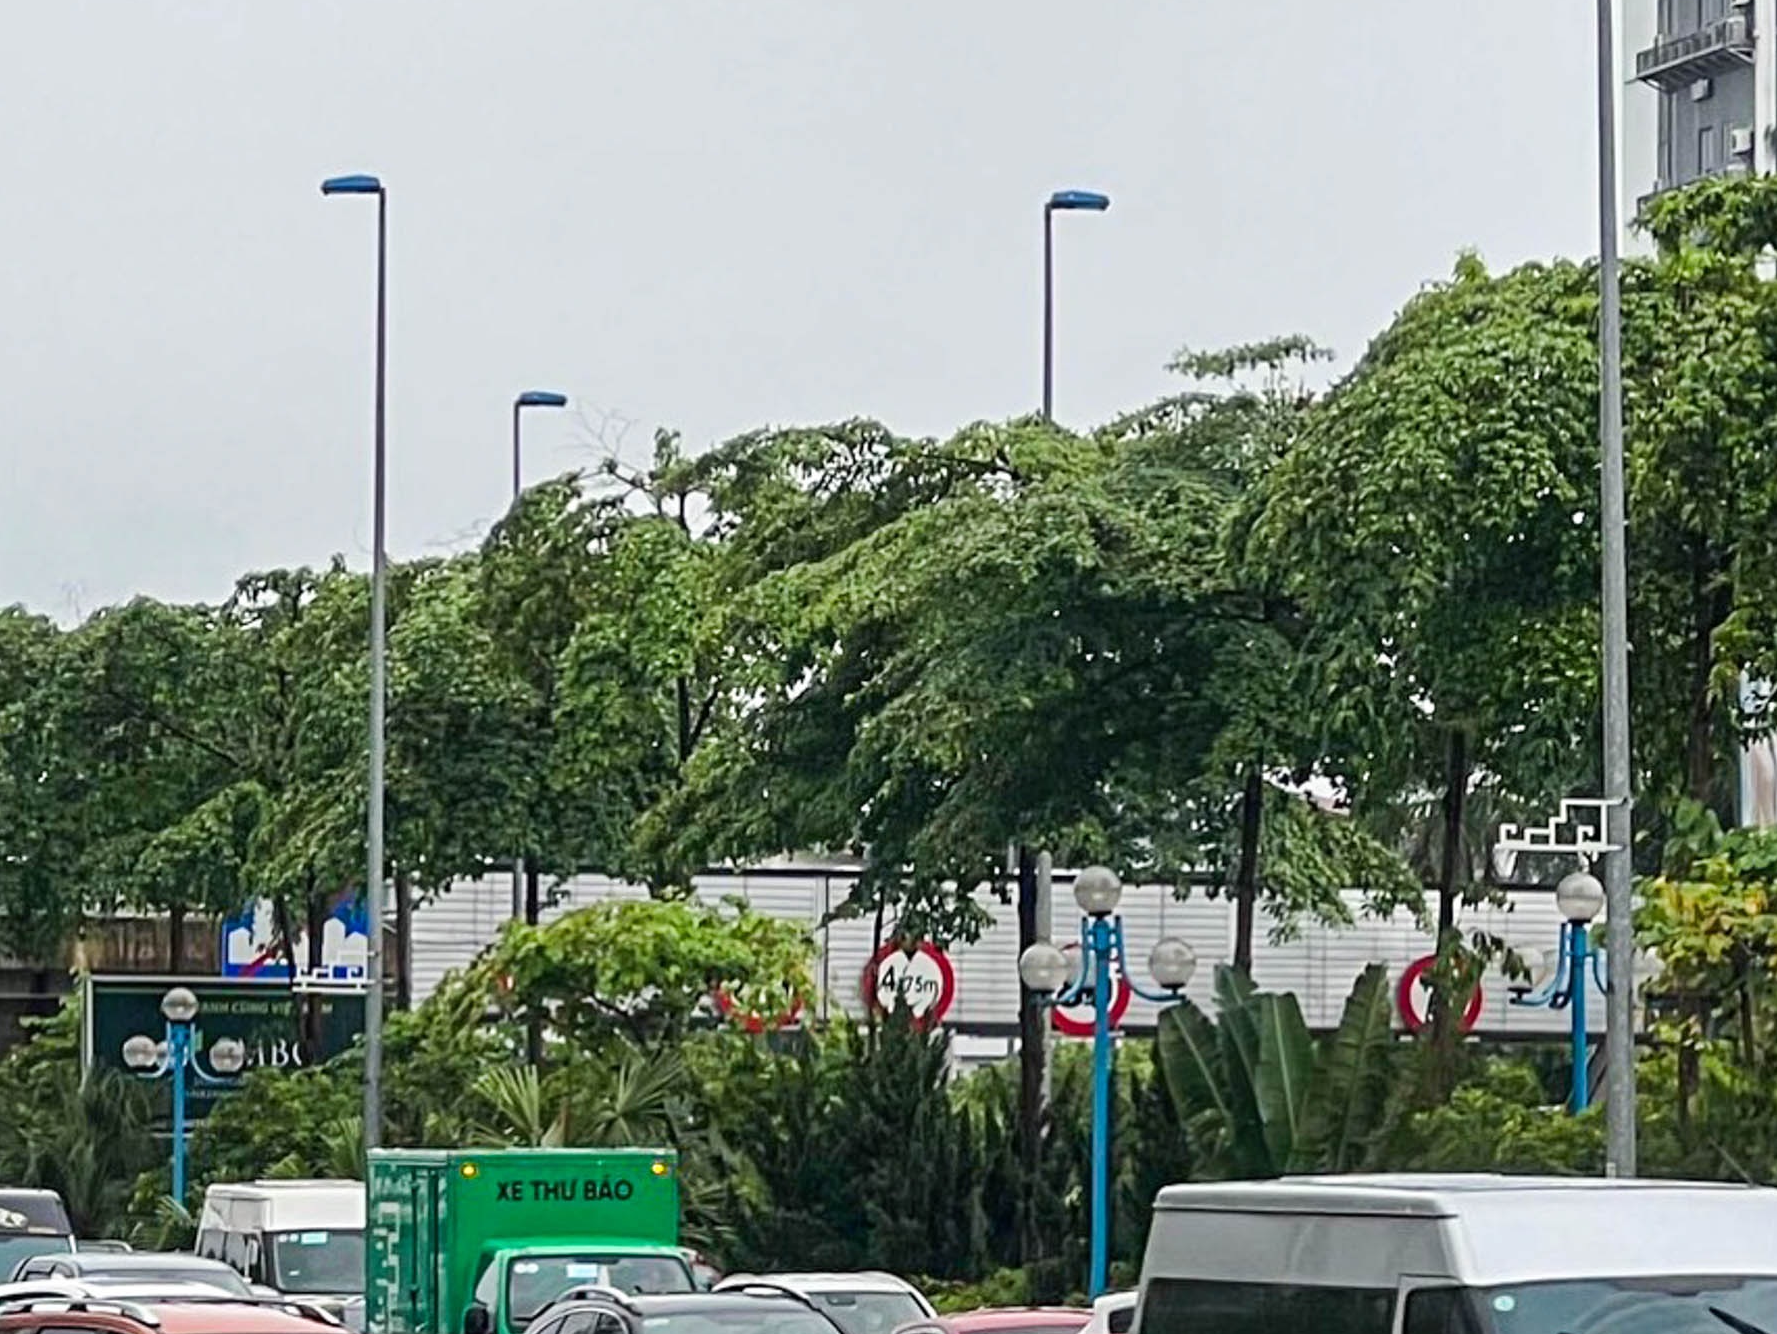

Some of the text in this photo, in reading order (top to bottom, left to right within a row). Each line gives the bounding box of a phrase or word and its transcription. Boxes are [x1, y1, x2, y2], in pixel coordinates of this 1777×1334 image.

[496, 1173, 634, 1202] XE THƯ BÁO
